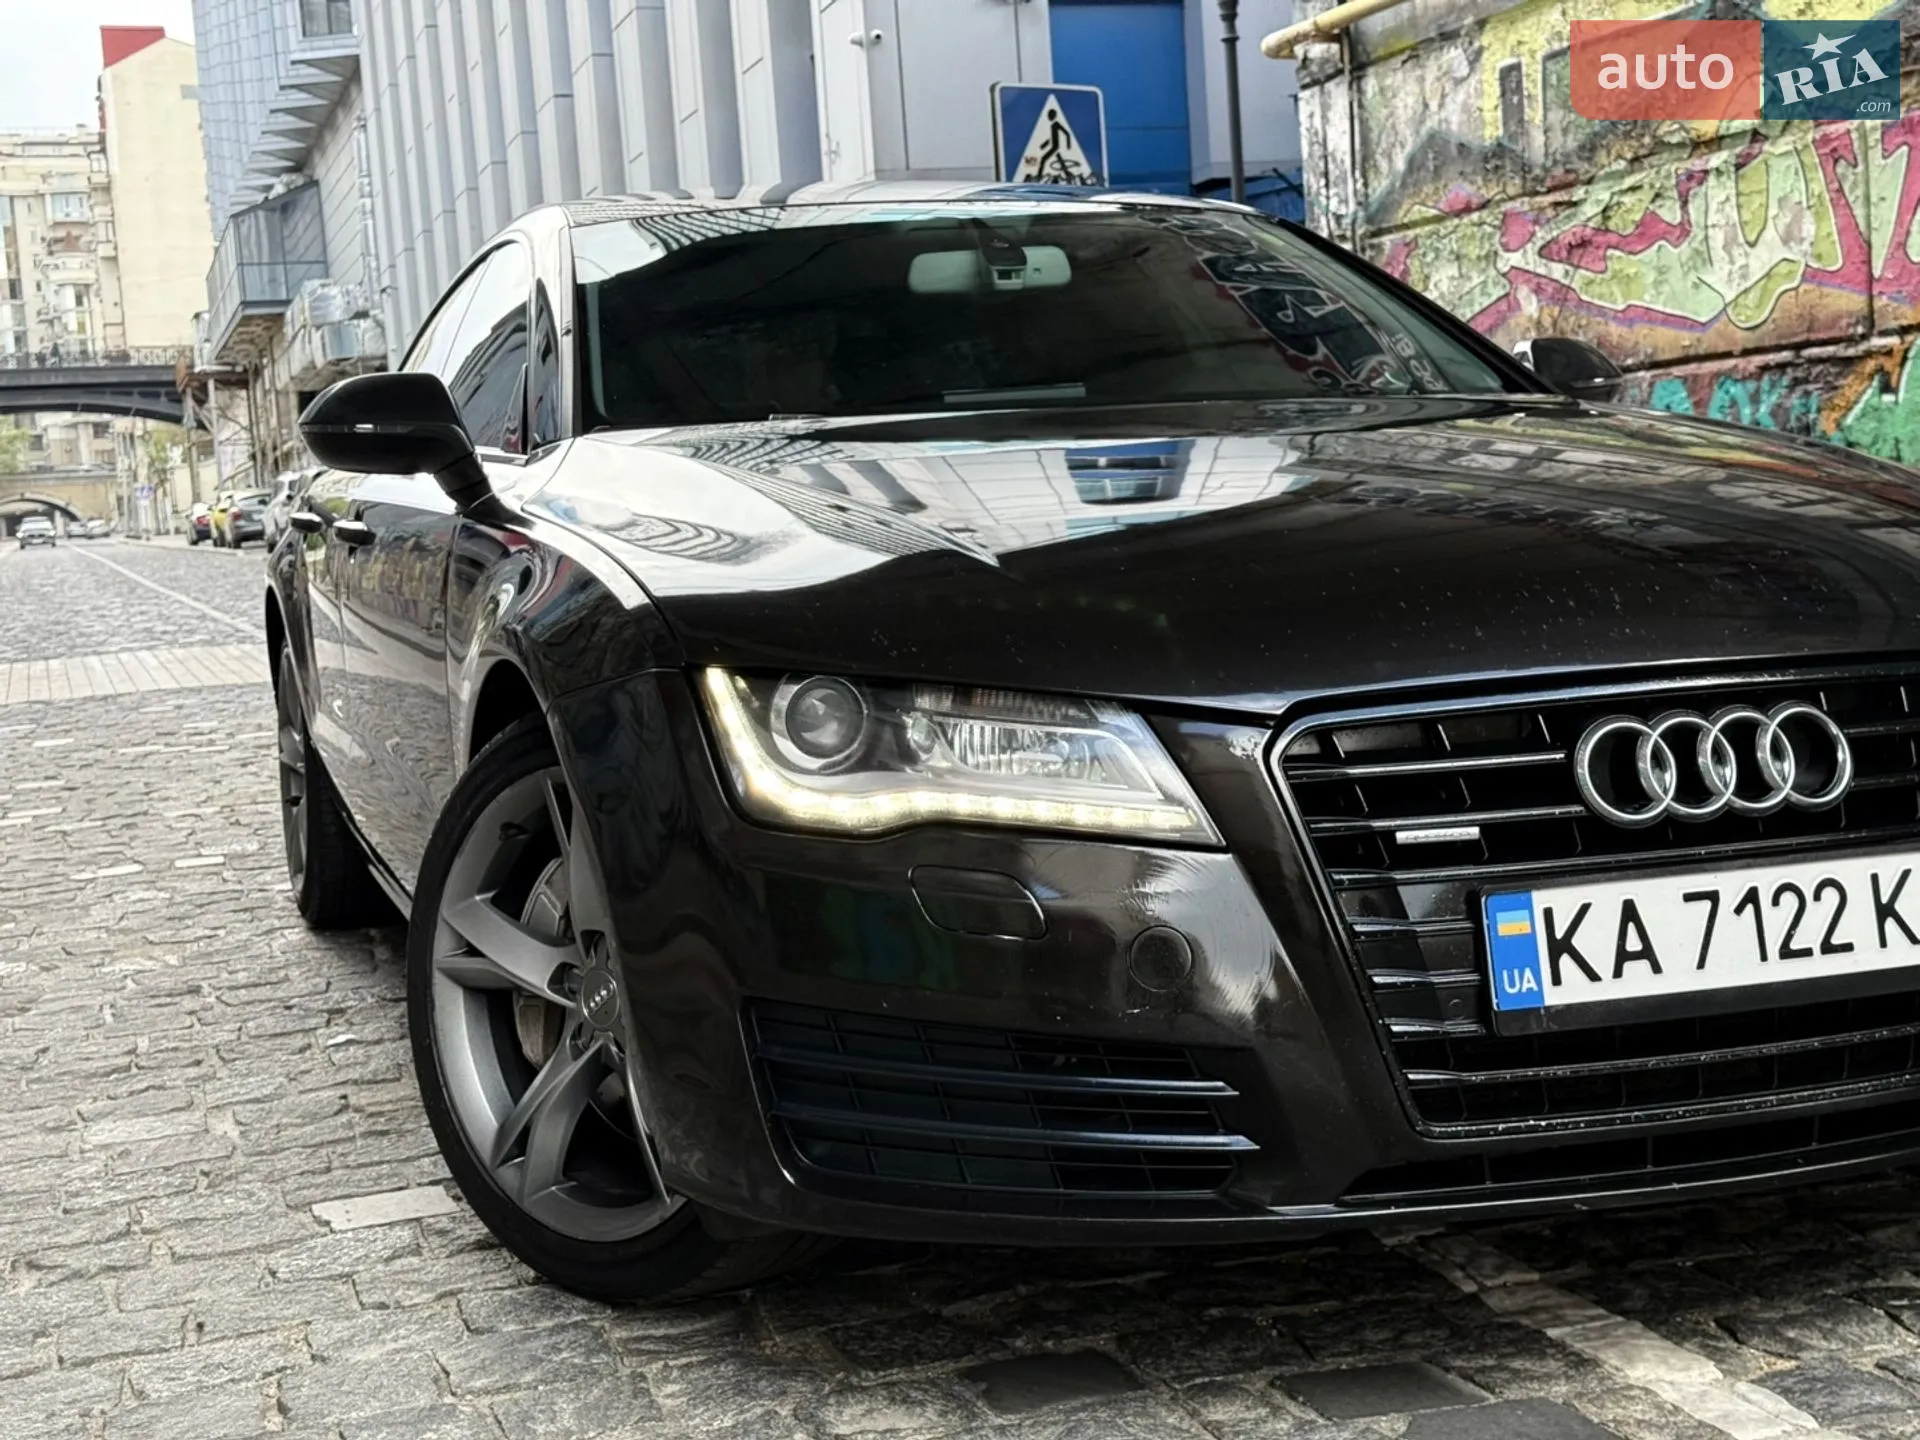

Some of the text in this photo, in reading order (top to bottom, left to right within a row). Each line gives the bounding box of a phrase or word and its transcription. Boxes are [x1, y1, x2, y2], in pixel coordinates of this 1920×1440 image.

[1542, 867, 1920, 987] KA 7122 K
[1502, 967, 1539, 995] UA
